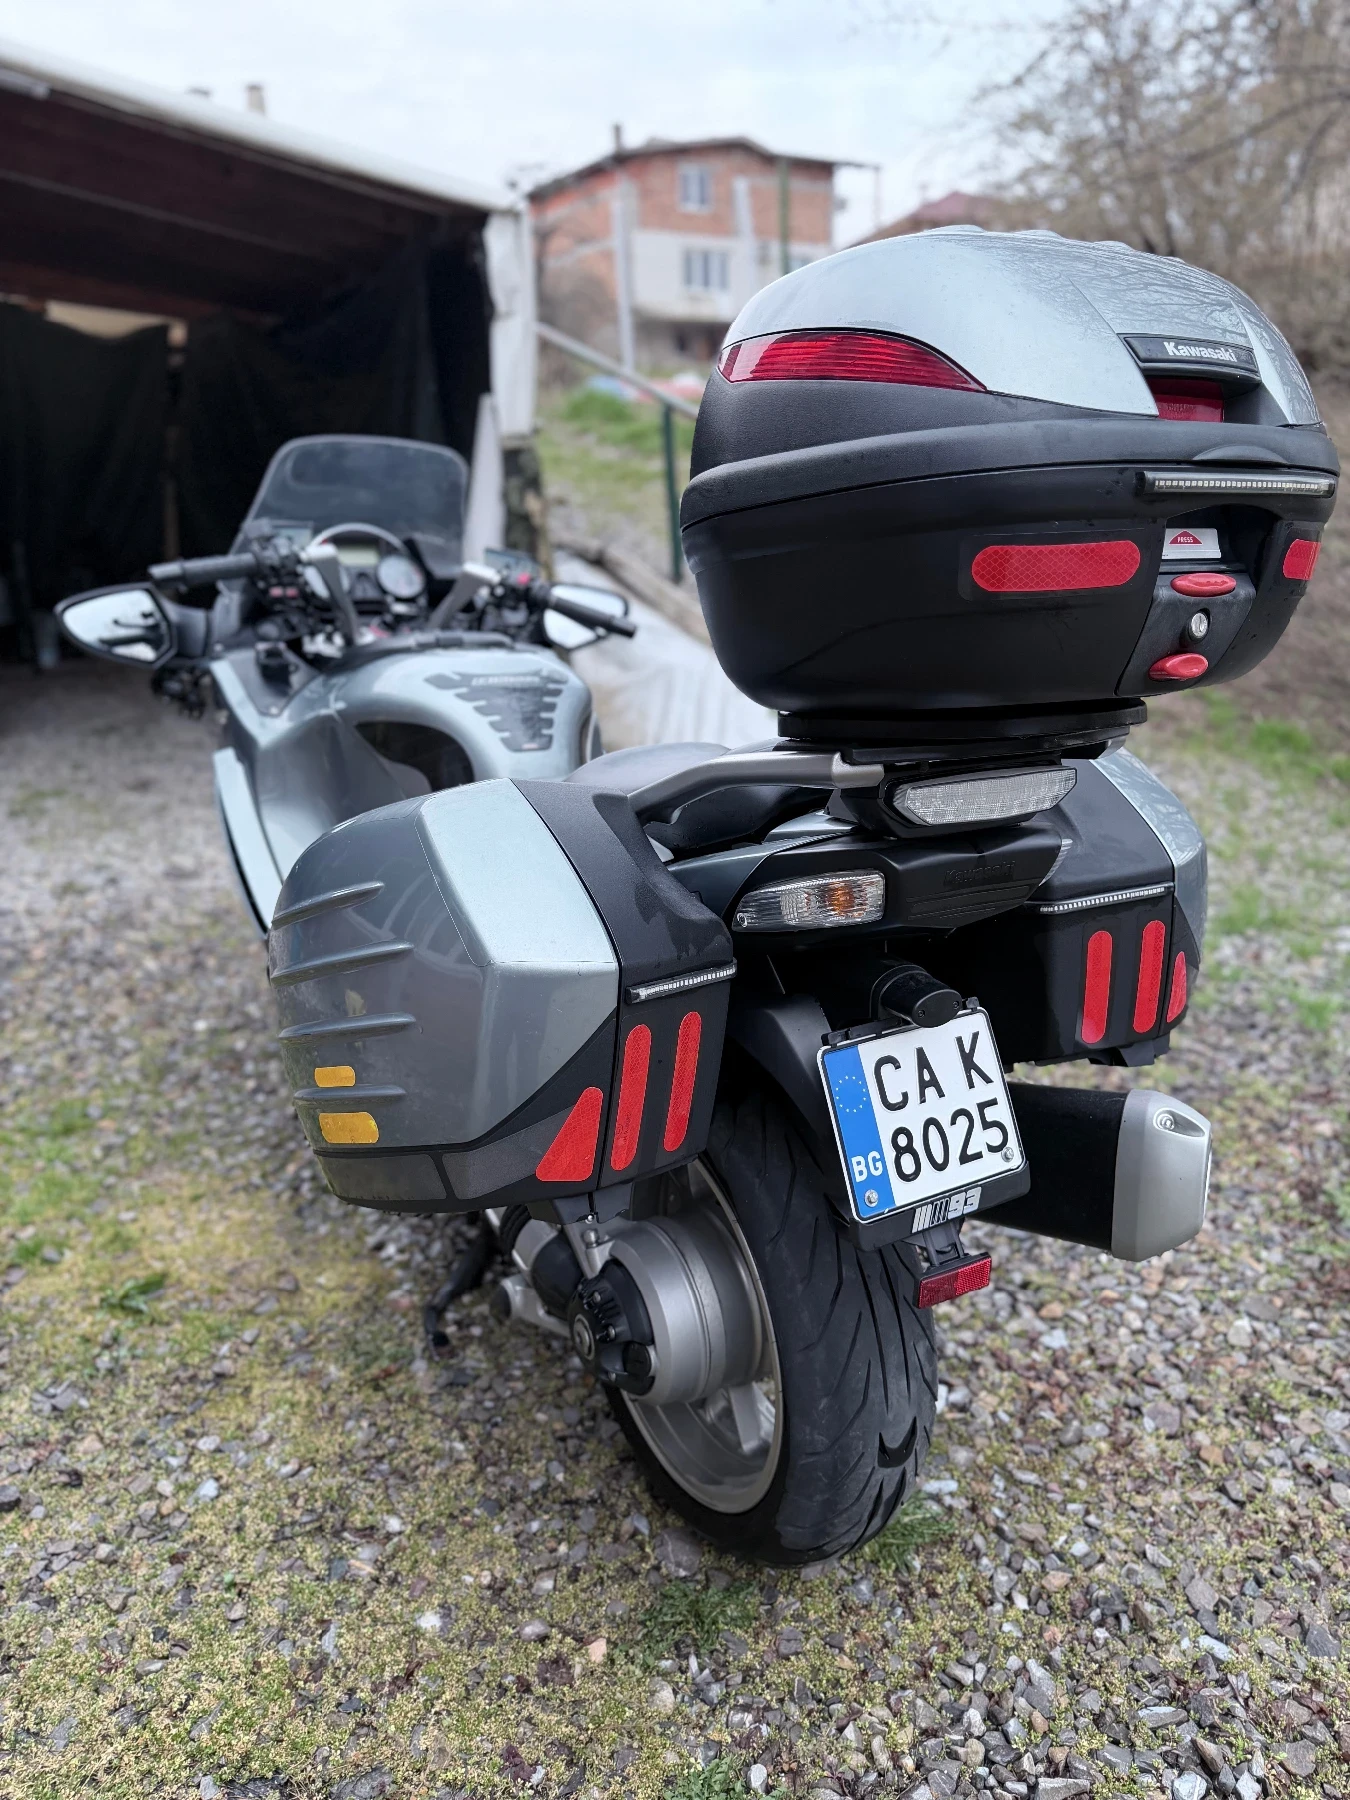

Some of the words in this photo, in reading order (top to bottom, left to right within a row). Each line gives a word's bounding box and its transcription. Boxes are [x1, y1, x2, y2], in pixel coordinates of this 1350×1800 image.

[1163, 341, 1237, 362] Kawasaki
[874, 1046, 945, 1111] CA
[955, 1030, 994, 1089] K
[851, 1150, 883, 1183] BG
[891, 1097, 1009, 1182] 8025
